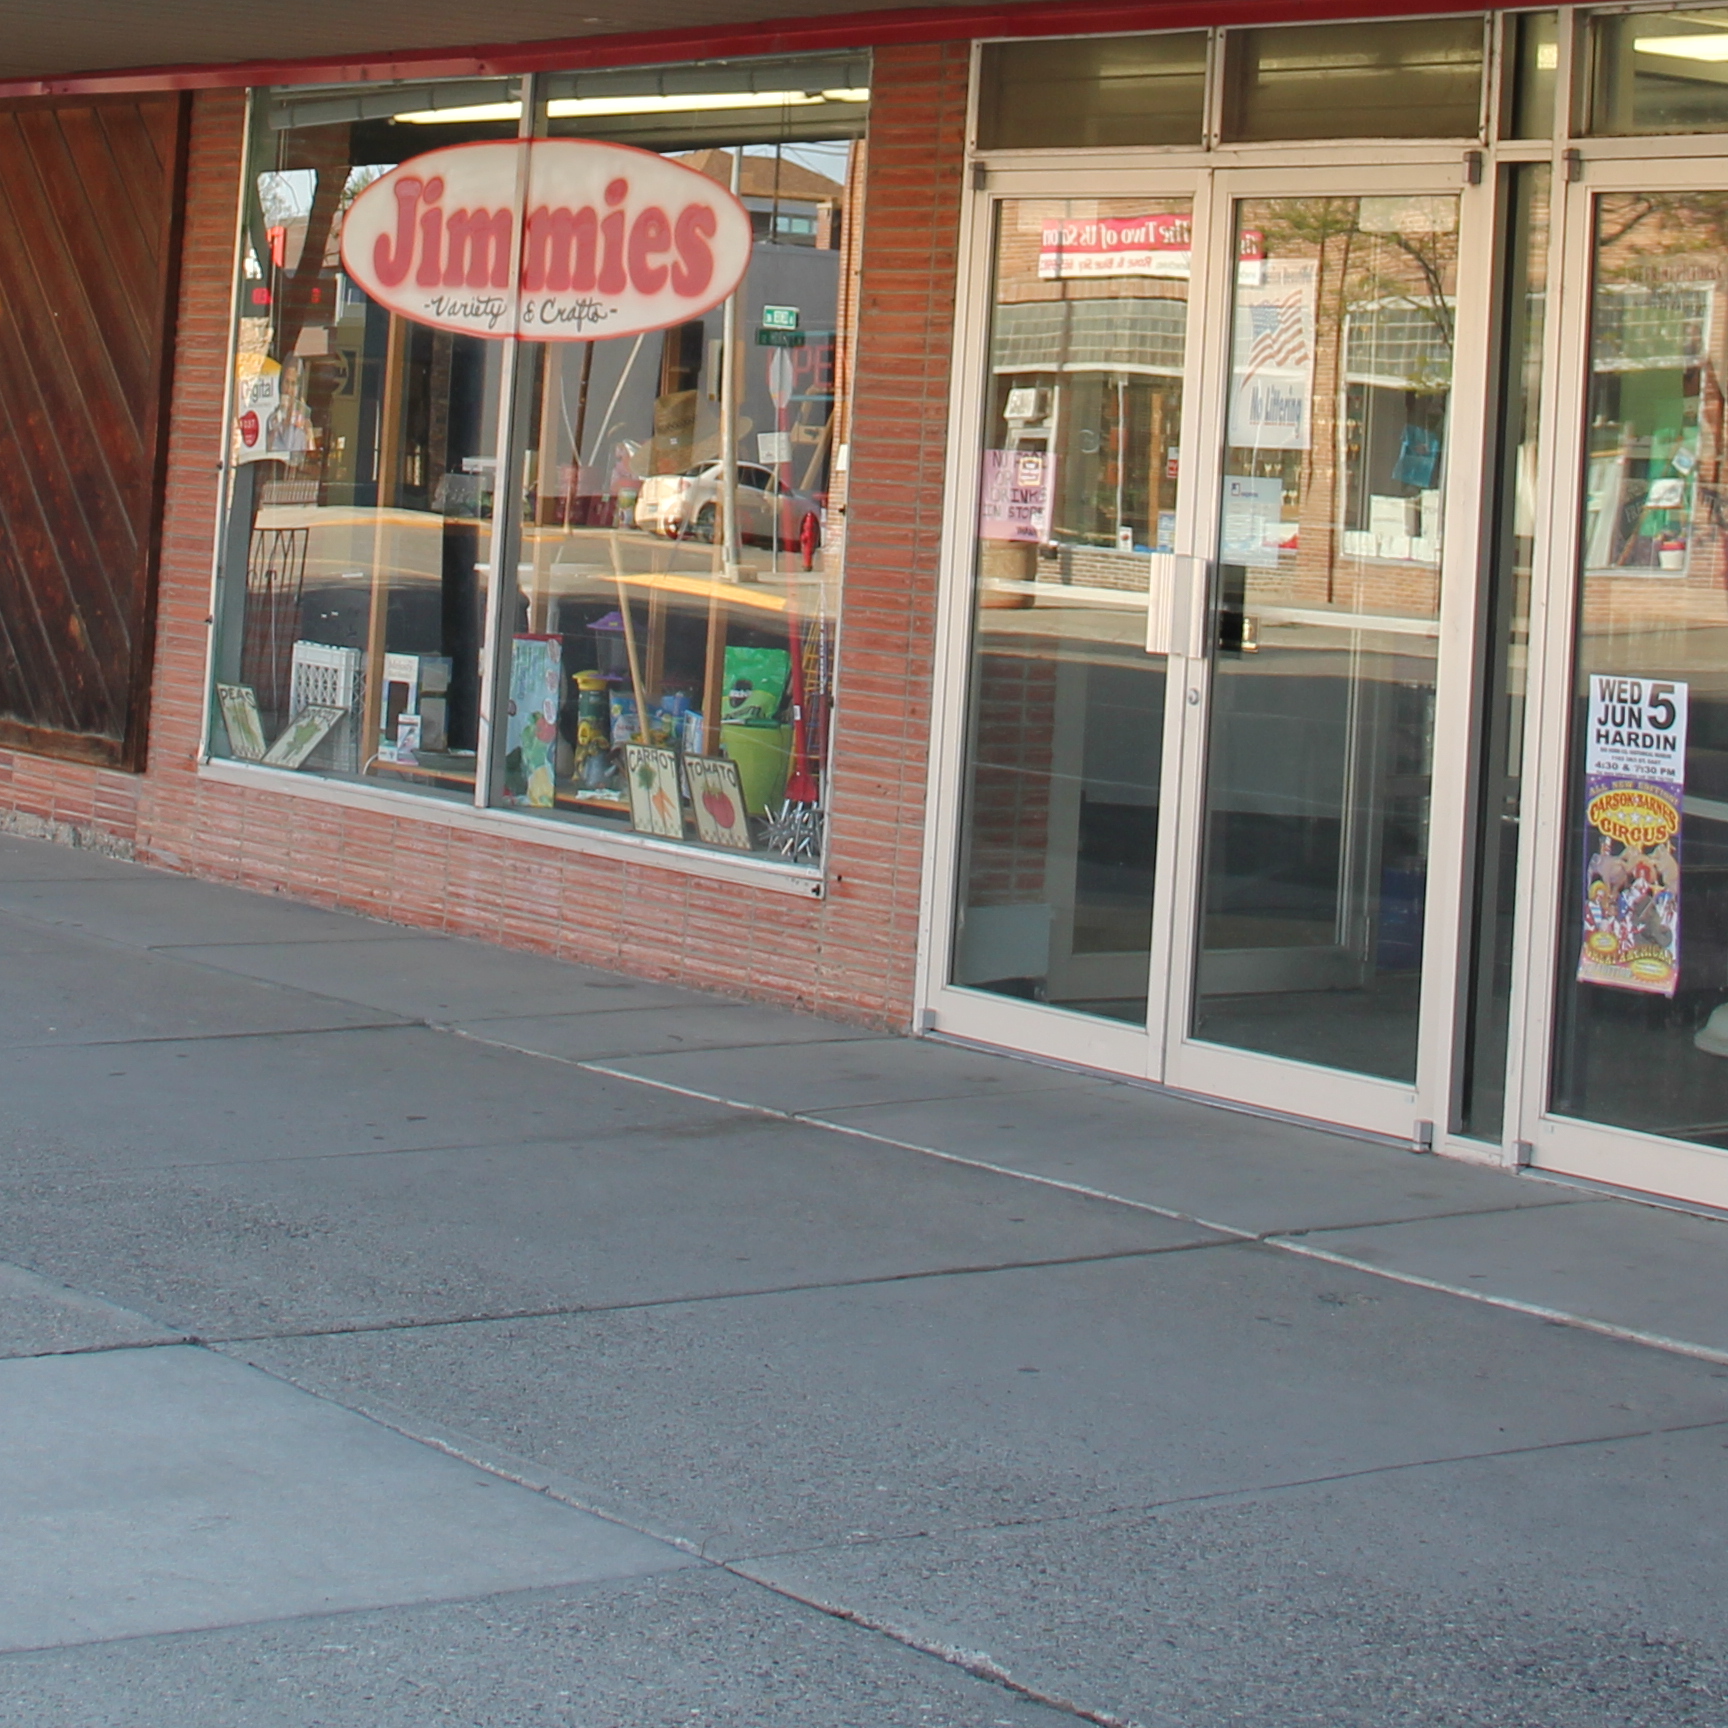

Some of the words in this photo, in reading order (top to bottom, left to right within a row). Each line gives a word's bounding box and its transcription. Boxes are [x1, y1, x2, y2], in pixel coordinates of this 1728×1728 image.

[373, 175, 718, 299] Jimmies
[522, 298, 535, 322] &
[219, 687, 258, 709] PEAS
[1598, 678, 1643, 705] WED
[1597, 704, 1643, 729] JUN
[1647, 683, 1677, 730] 5
[1595, 728, 1677, 752] HARDIN
[628, 748, 677, 779] CARROT
[686, 761, 737, 788] TOMATO
[1595, 760, 1619, 771] 4:30
[1600, 817, 1668, 845] CIRCUS
